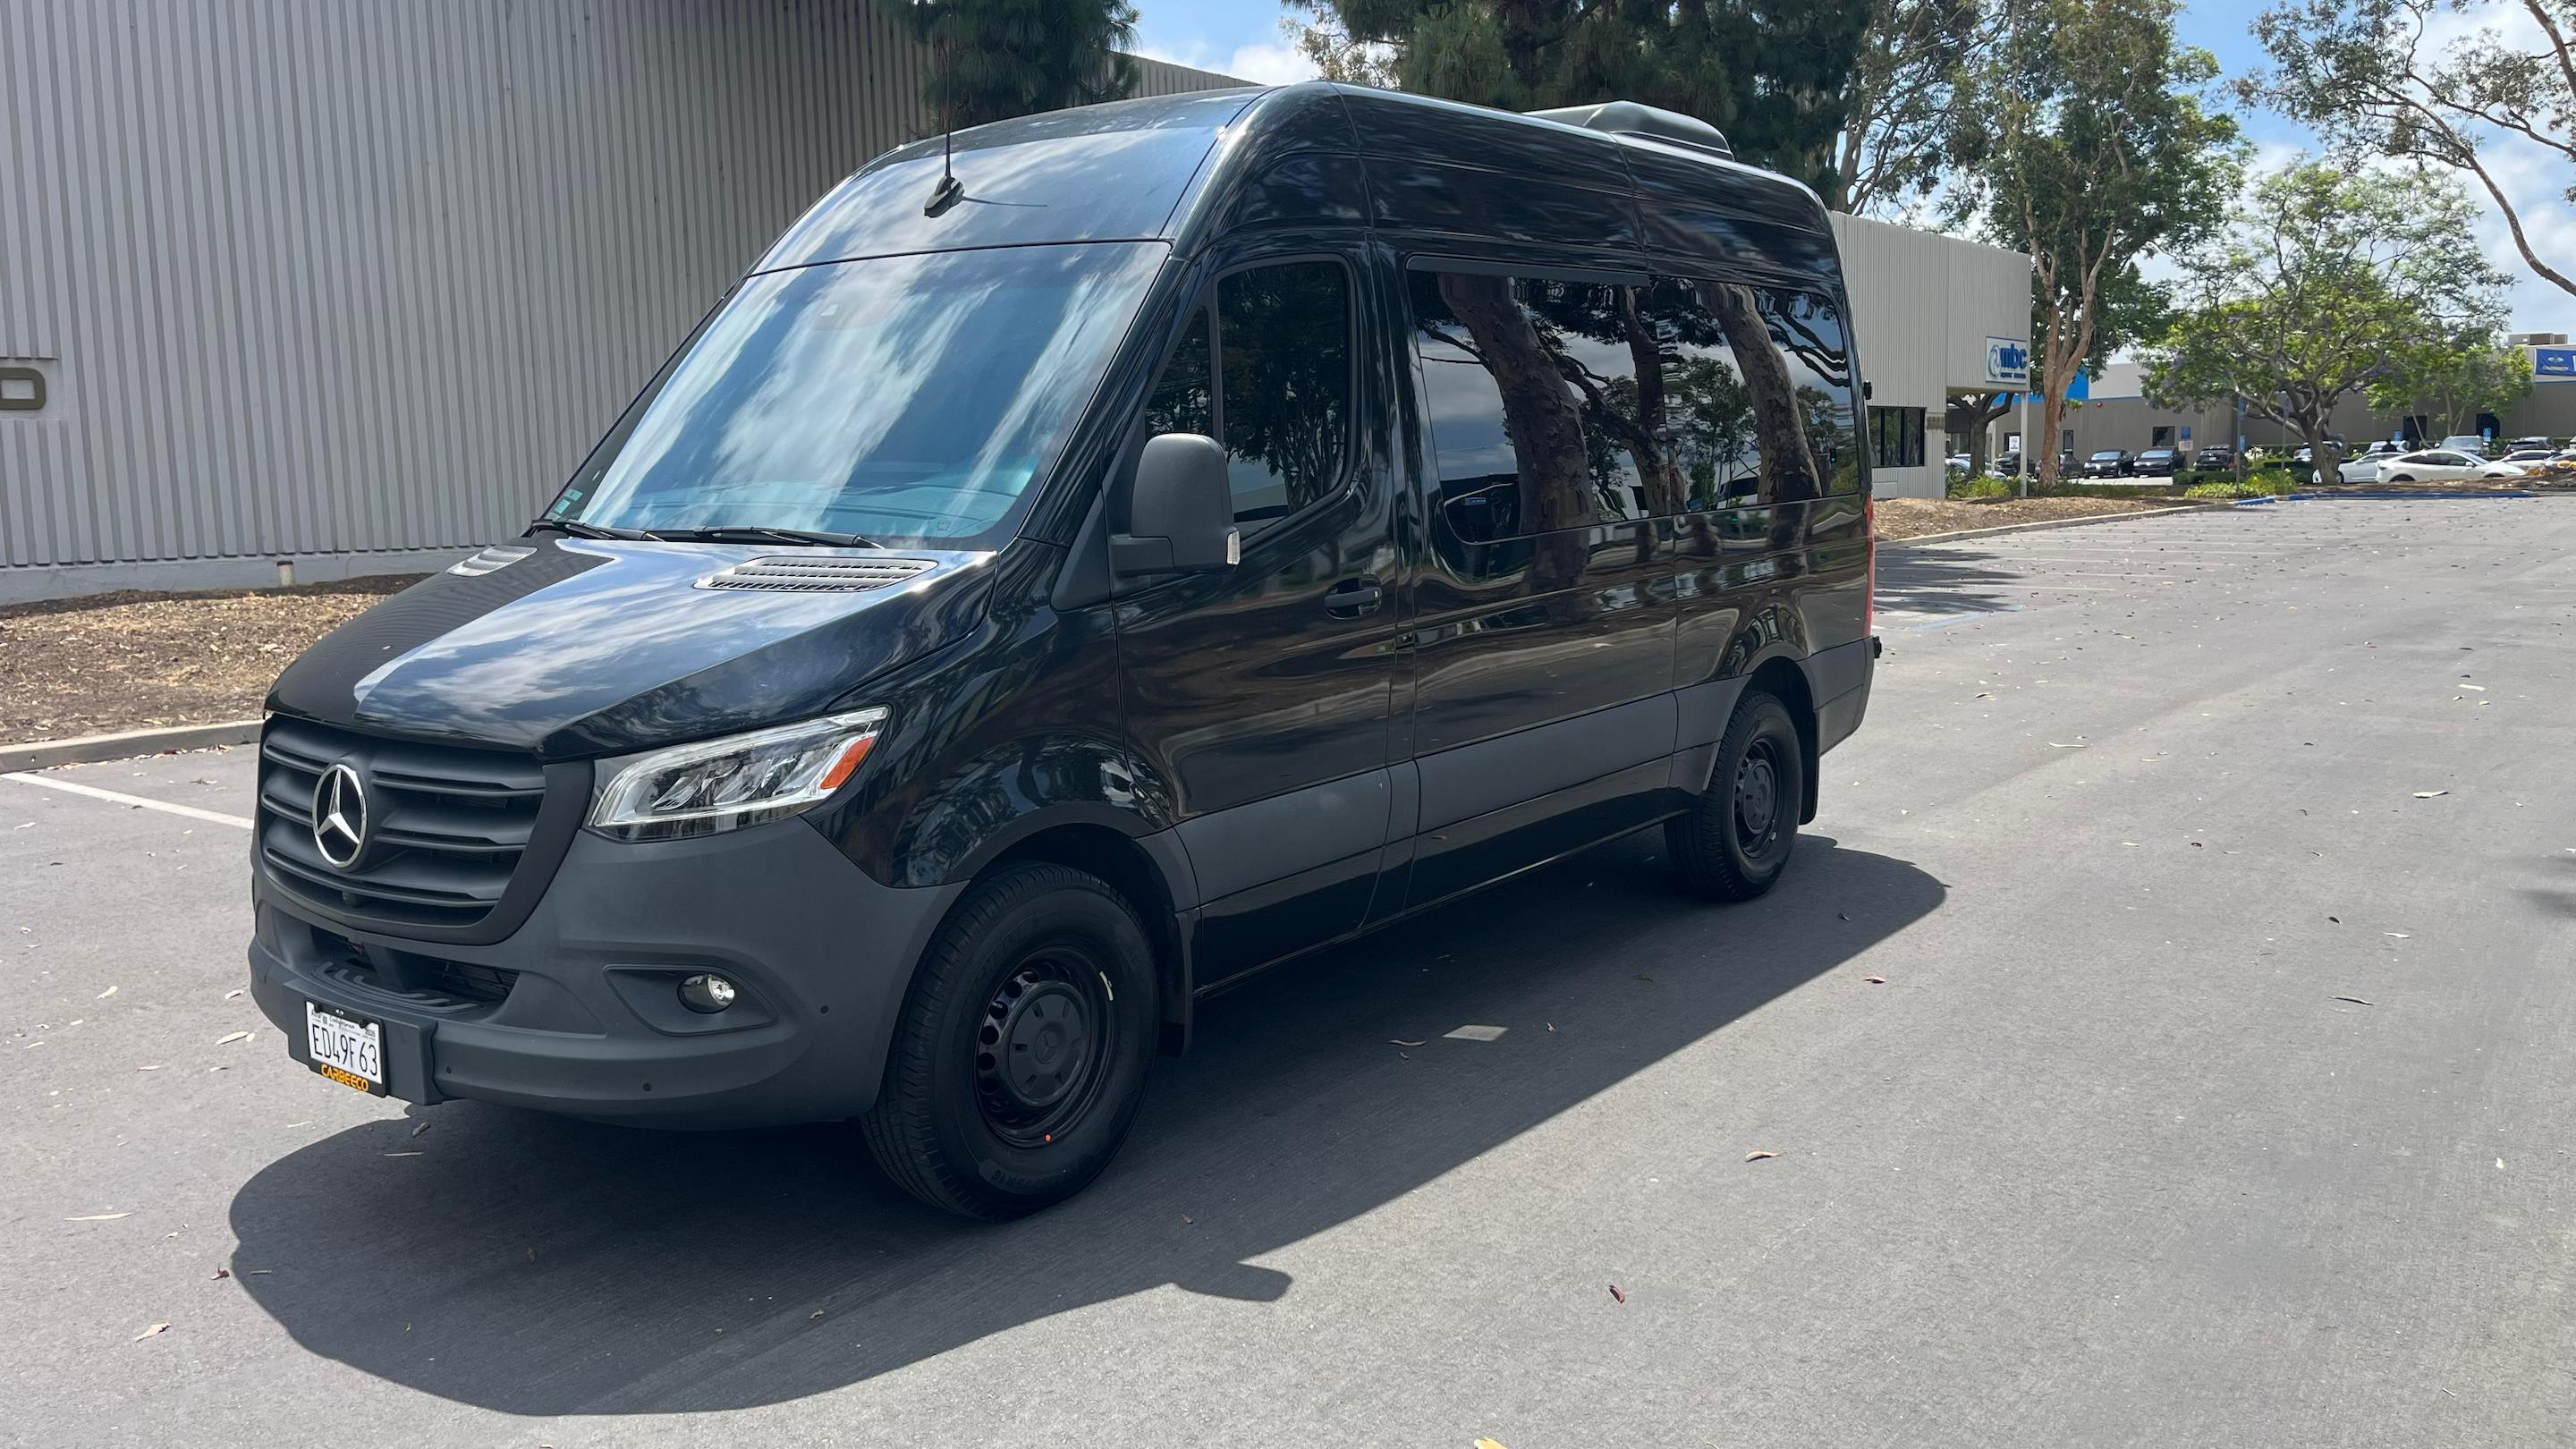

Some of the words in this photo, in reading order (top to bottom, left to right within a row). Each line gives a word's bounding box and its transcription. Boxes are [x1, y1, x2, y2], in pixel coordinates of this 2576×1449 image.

[2000, 343, 2027, 369] mbc
[312, 1024, 377, 1076] ED49F63
[321, 1063, 369, 1091] CARBEECO
